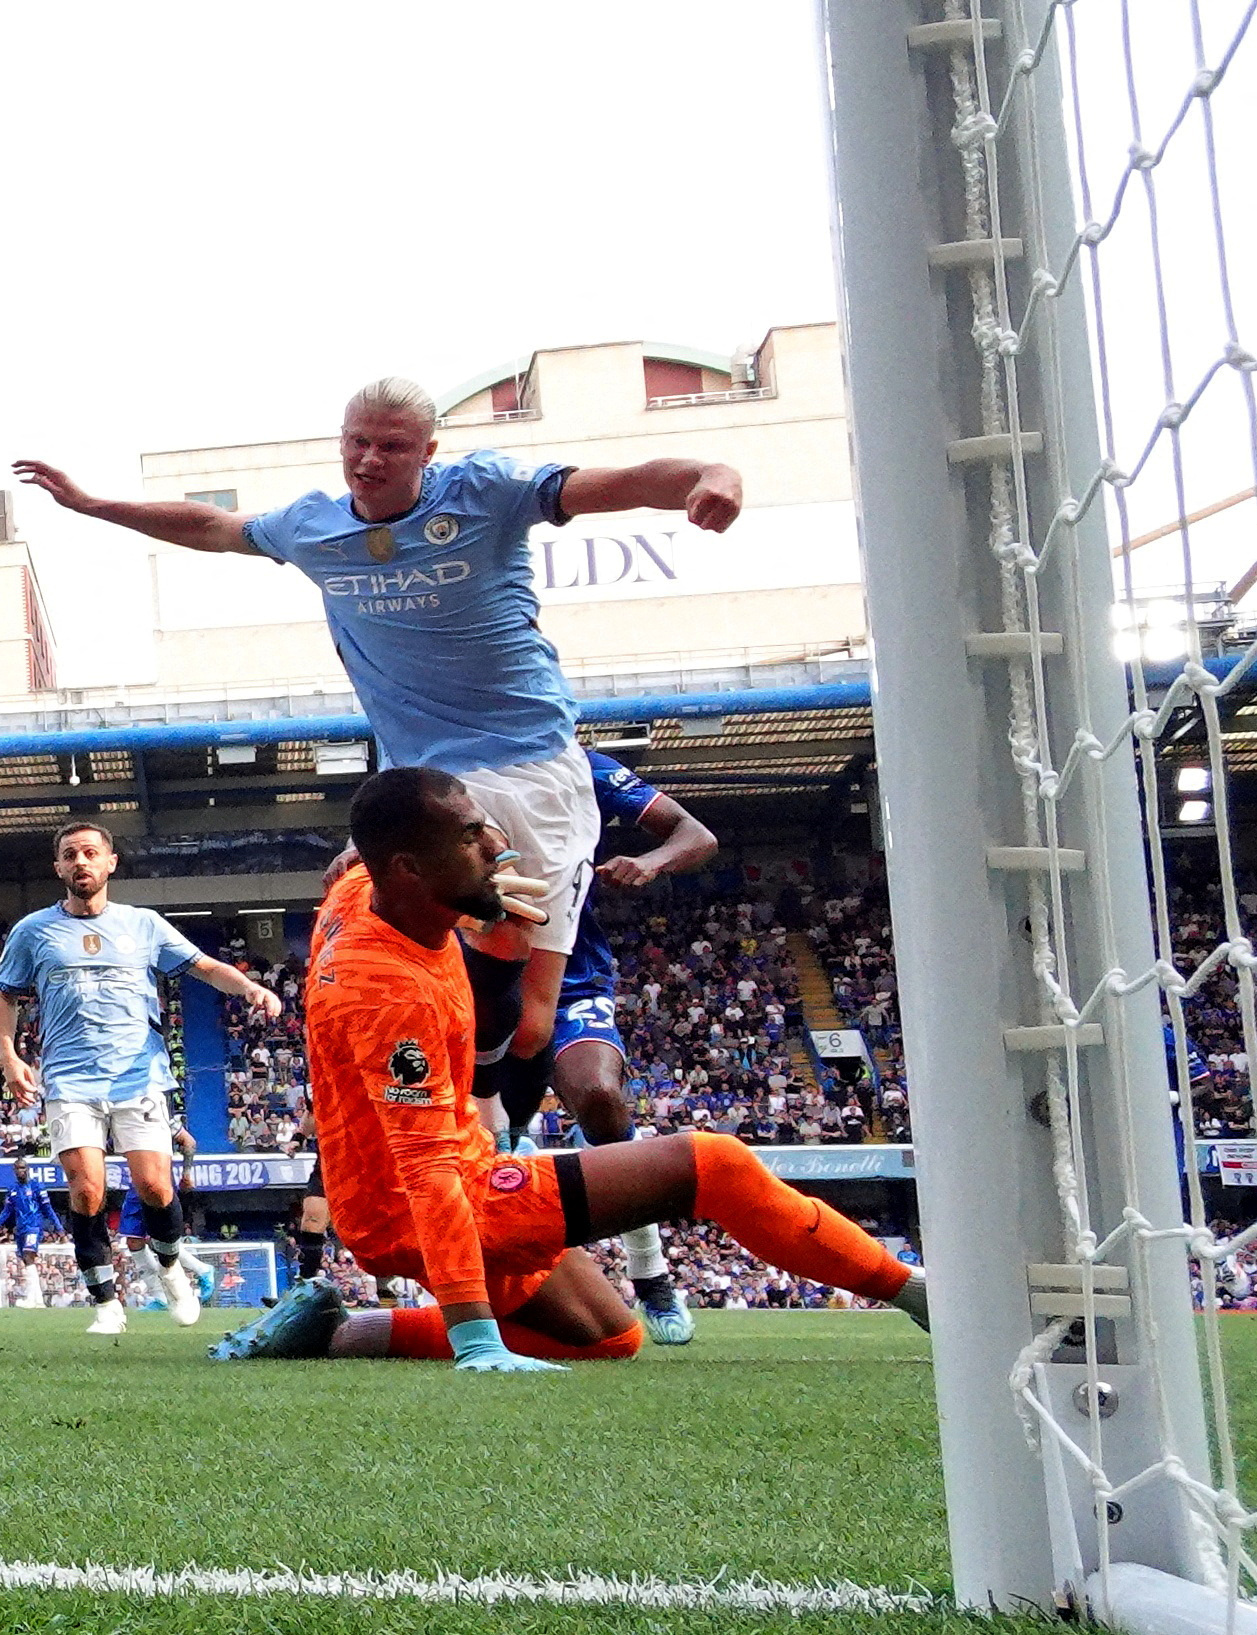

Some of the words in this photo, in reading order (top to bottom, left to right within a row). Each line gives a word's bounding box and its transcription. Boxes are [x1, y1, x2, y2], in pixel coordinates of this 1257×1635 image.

[540, 531, 678, 589] LDN
[324, 560, 472, 596] ETIHAD
[357, 593, 441, 616] AIRWAYS
[829, 1032, 842, 1048] 6
[28, 1166, 57, 1183] HE
